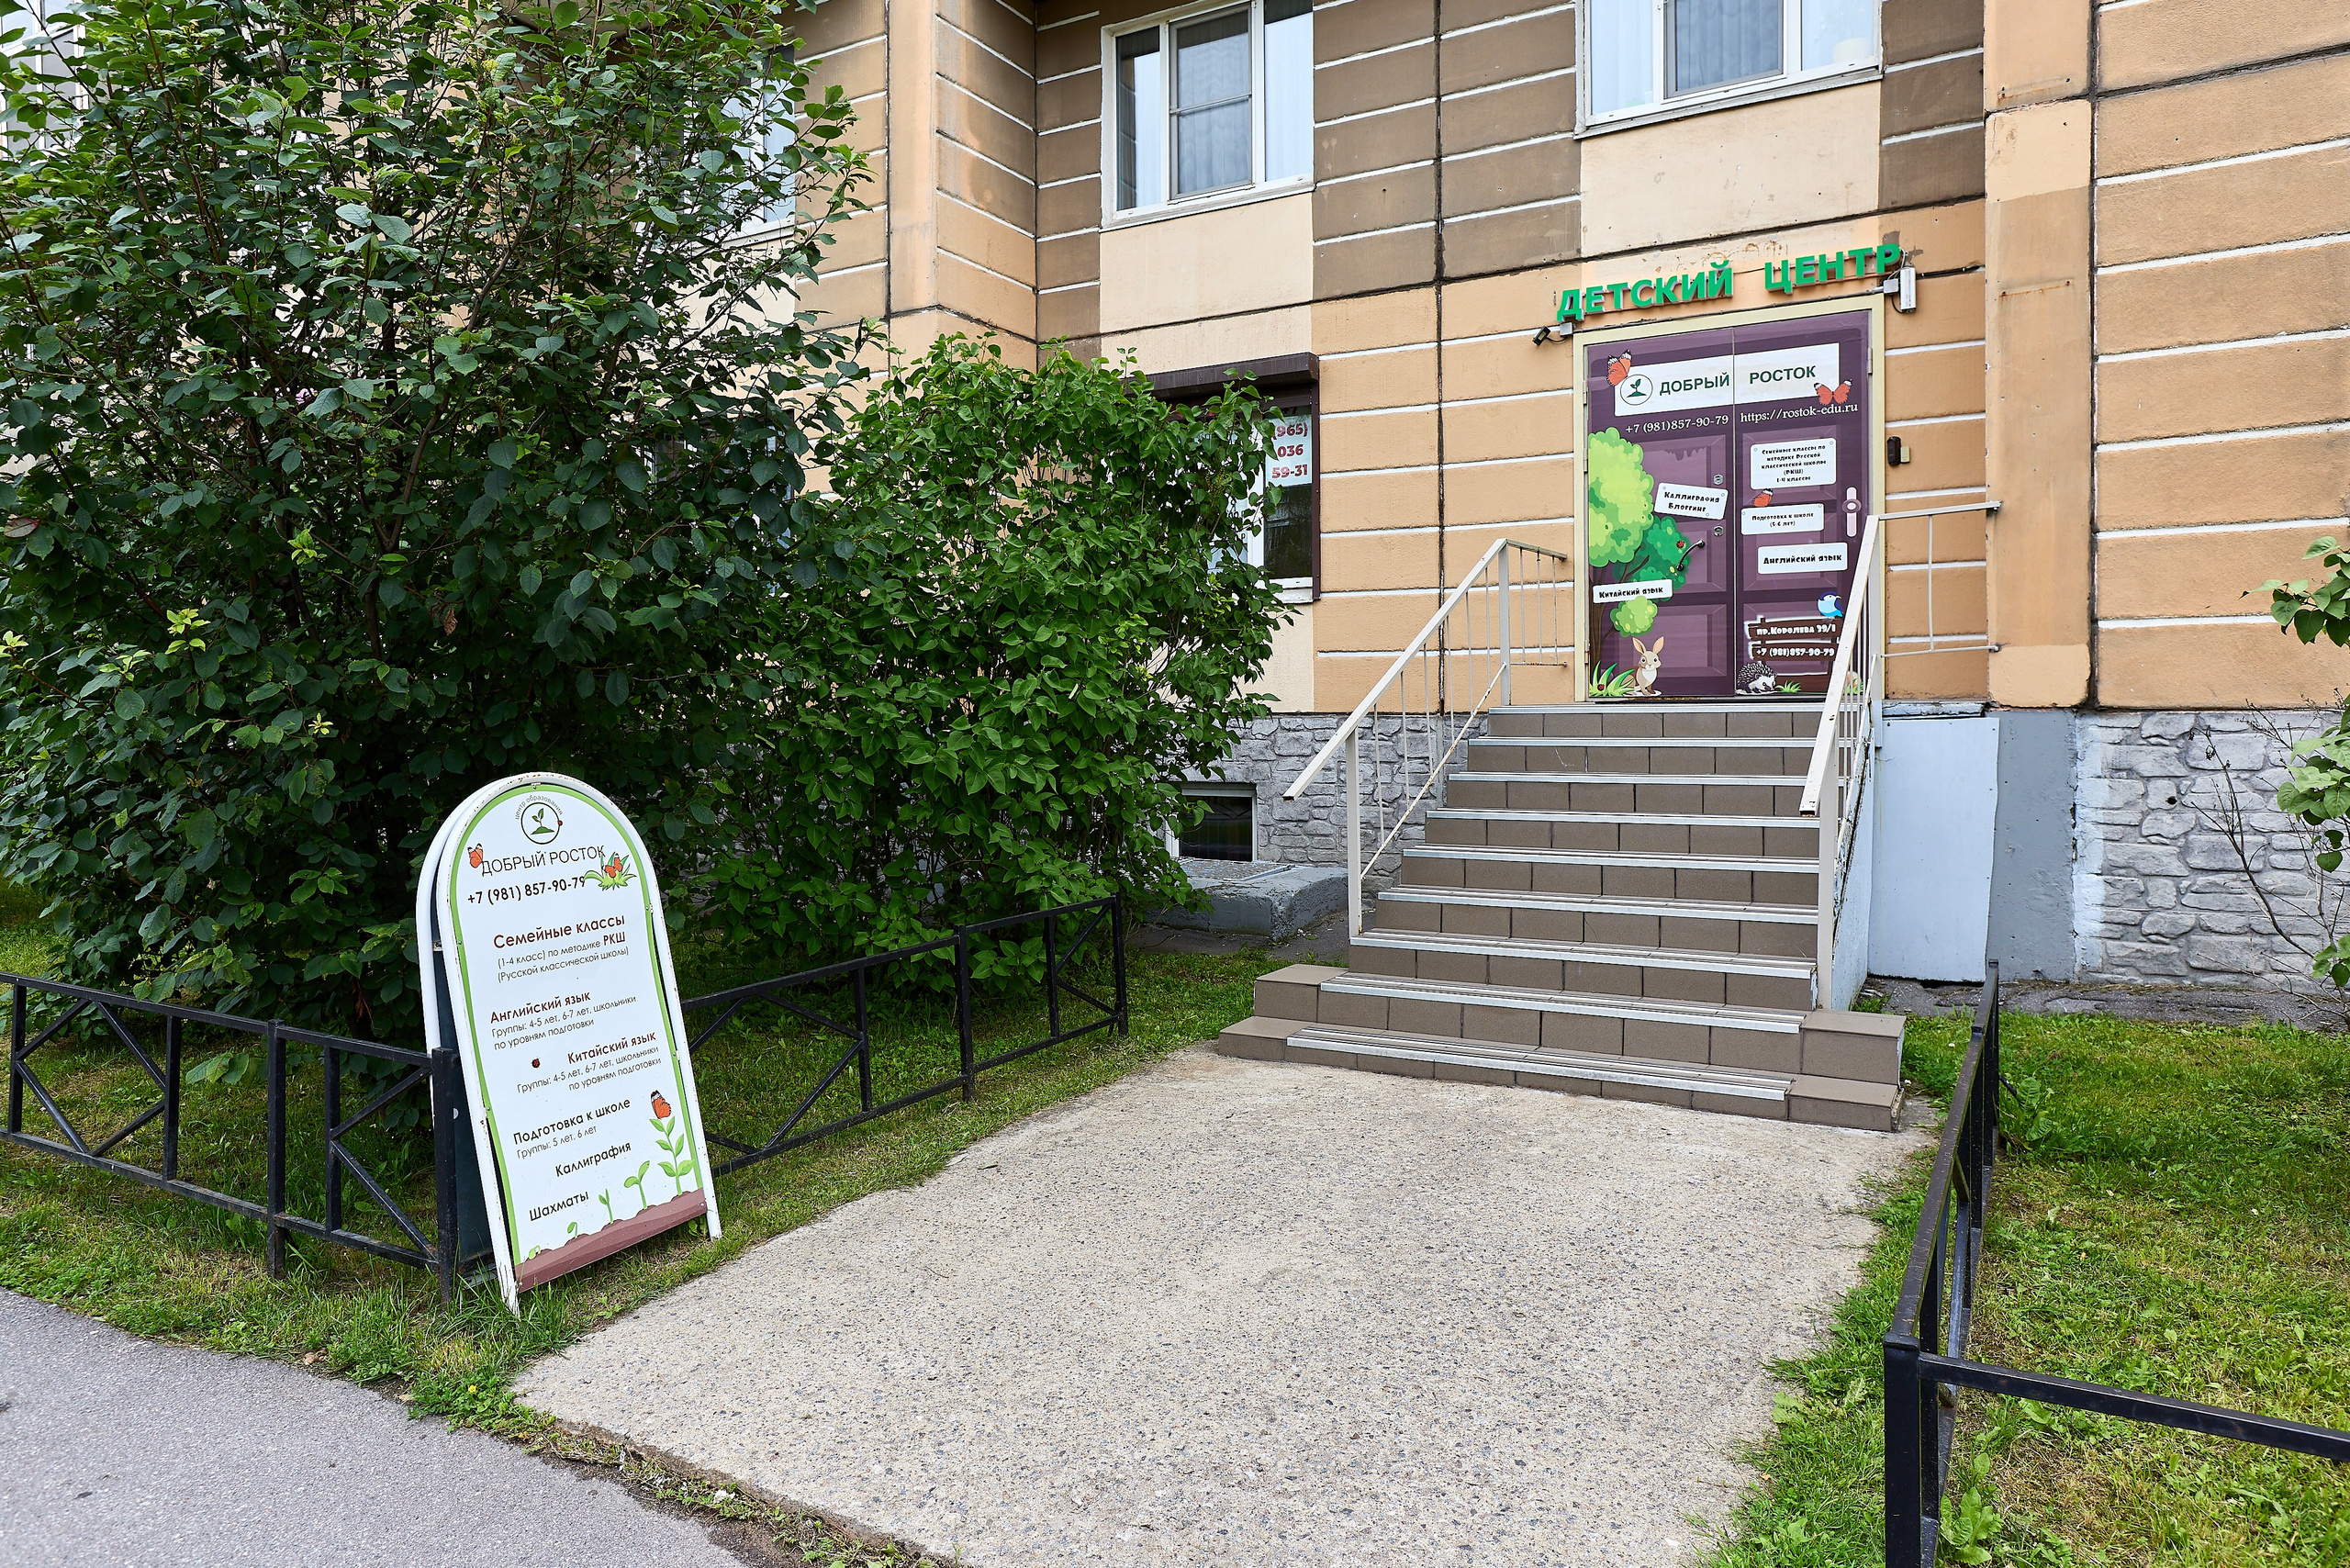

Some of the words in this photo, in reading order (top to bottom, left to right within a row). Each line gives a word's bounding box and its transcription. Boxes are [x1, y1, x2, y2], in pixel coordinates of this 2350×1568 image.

[1557, 260, 1733, 322] ДЕТСКИЙ
[1764, 243, 1901, 294] ЦЕНТР
[1660, 372, 1729, 396] ДОБРЫЙ
[1750, 365, 1817, 385] РОСТОК
[1626, 423, 1639, 434] +7
[1643, 415, 1729, 433] (981)857-90-79
[1740, 403, 1858, 423] https://rostok-edu.ru
[1277, 444, 1304, 458] 036
[1272, 464, 1308, 479] 59-31
[1763, 554, 1816, 565] Английский
[1599, 588, 1640, 599] Китайский
[1642, 587, 1663, 595] язык
[1756, 648, 1767, 656] +7
[515, 801, 526, 821] центр
[526, 795, 564, 816] образования
[482, 850, 546, 877] ДОБРЫЙ
[549, 845, 606, 865] РОСТОК
[467, 891, 483, 904] +7
[487, 885, 521, 905] (981)
[525, 876, 586, 897] 857-90-79
[493, 925, 572, 949] Семейные
[576, 915, 625, 934] классы
[498, 957, 514, 969] (1-4
[516, 950, 546, 965] класс)
[548, 949, 559, 958] по
[560, 940, 601, 956] методике
[603, 931, 626, 946] РКШ
[498, 965, 538, 983] (Русской
[540, 952, 599, 973] классической
[600, 946, 629, 960] школы)
[490, 996, 562, 1024] Английский
[565, 992, 591, 1006] язык
[491, 1023, 527, 1038] Группы:
[529, 1018, 543, 1028] 4-5
[544, 1014, 561, 1025] лет,
[562, 1010, 574, 1021] 6-7
[576, 1006, 592, 1016] лет,
[593, 996, 637, 1013] школьники
[494, 1041, 507, 1050] по
[508, 1031, 546, 1048] уровням
[548, 1019, 595, 1036] подготовки
[567, 1037, 629, 1064] Китайский
[631, 1032, 656, 1047] язык
[517, 1077, 552, 1093] Группы:
[553, 1071, 566, 1082] 4-5
[567, 1068, 584, 1079] лет,
[585, 1063, 597, 1074] 6-7
[599, 1059, 614, 1070] лет,
[615, 1047, 659, 1065] школьники
[568, 1082, 580, 1091] по
[581, 1071, 617, 1090] уровням
[618, 1058, 661, 1078] подготовки
[513, 1114, 584, 1145] Подготовка
[586, 1112, 593, 1121] к
[595, 1099, 631, 1117] школе
[517, 1141, 551, 1159] Группы:
[553, 1137, 558, 1147] 5
[560, 1133, 576, 1144] лет,
[577, 1129, 583, 1138] 6
[584, 1125, 597, 1136] лет
[554, 1142, 632, 1177] Каллиграфия
[529, 1191, 589, 1222] Шахматы
